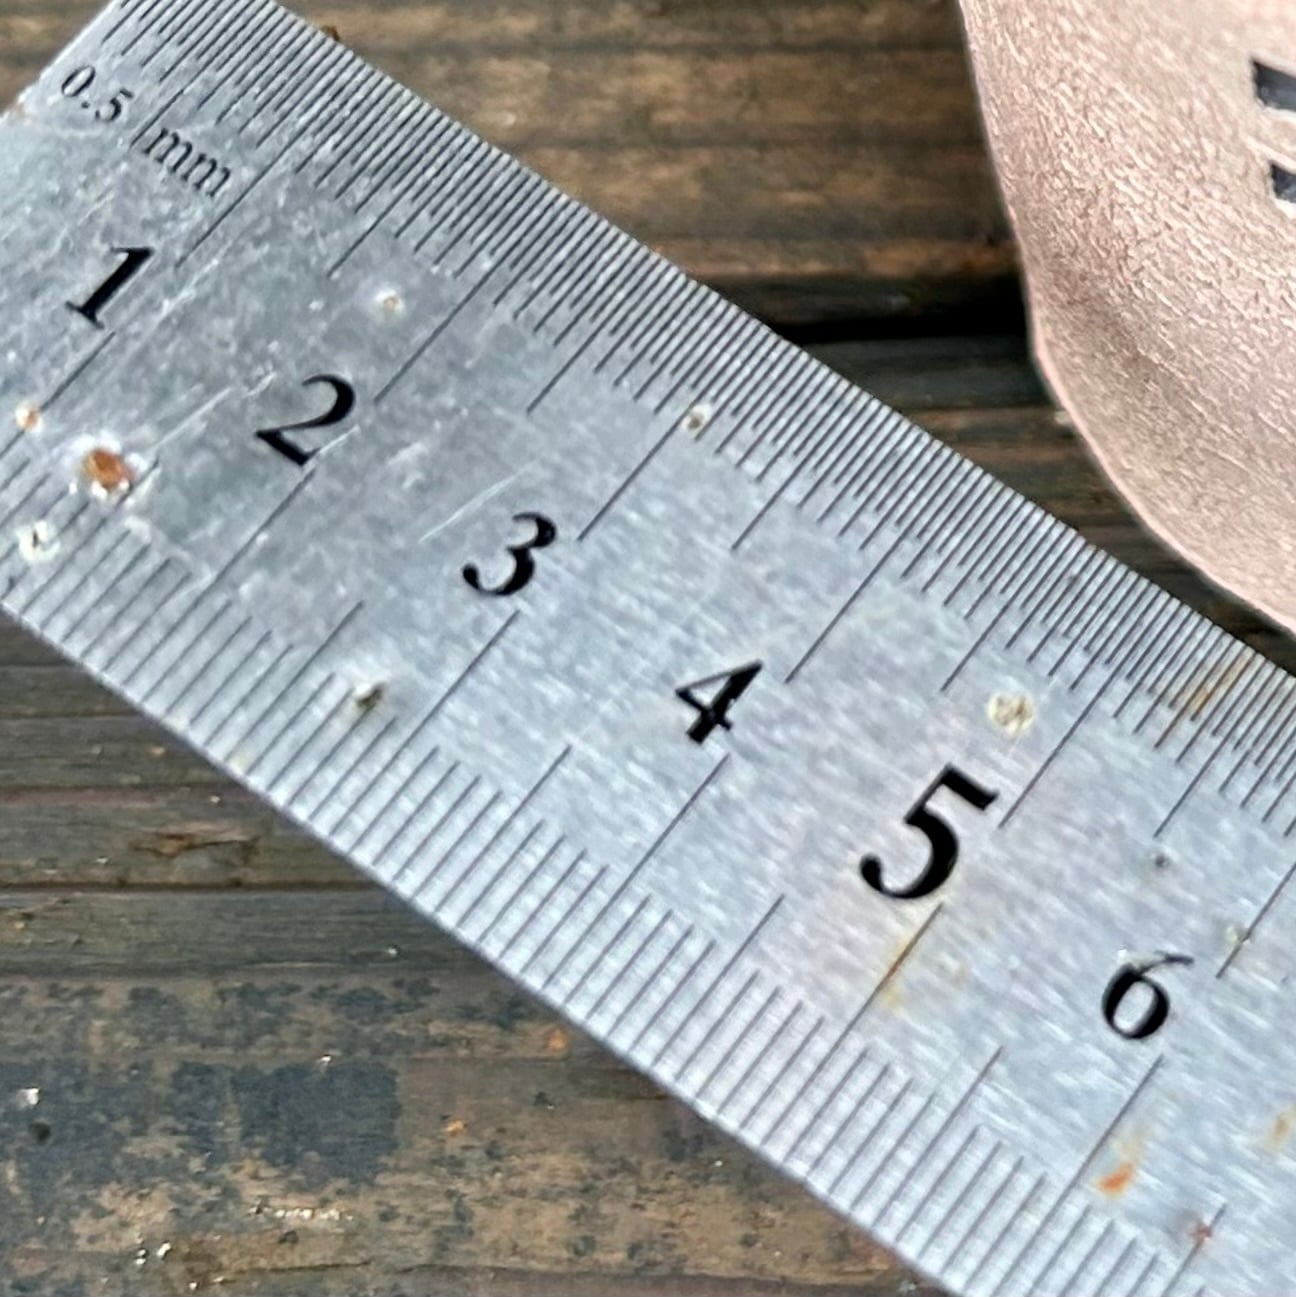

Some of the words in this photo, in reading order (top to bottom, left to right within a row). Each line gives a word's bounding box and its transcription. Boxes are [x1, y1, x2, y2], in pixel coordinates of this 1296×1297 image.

[61, 65, 133, 122] 0.5
[144, 128, 231, 197] mm
[65, 246, 155, 329] 1
[255, 374, 355, 466] 2
[462, 512, 556, 596] 3
[676, 661, 763, 744] 4
[860, 763, 998, 899] 5
[1101, 950, 1194, 1039] 6
